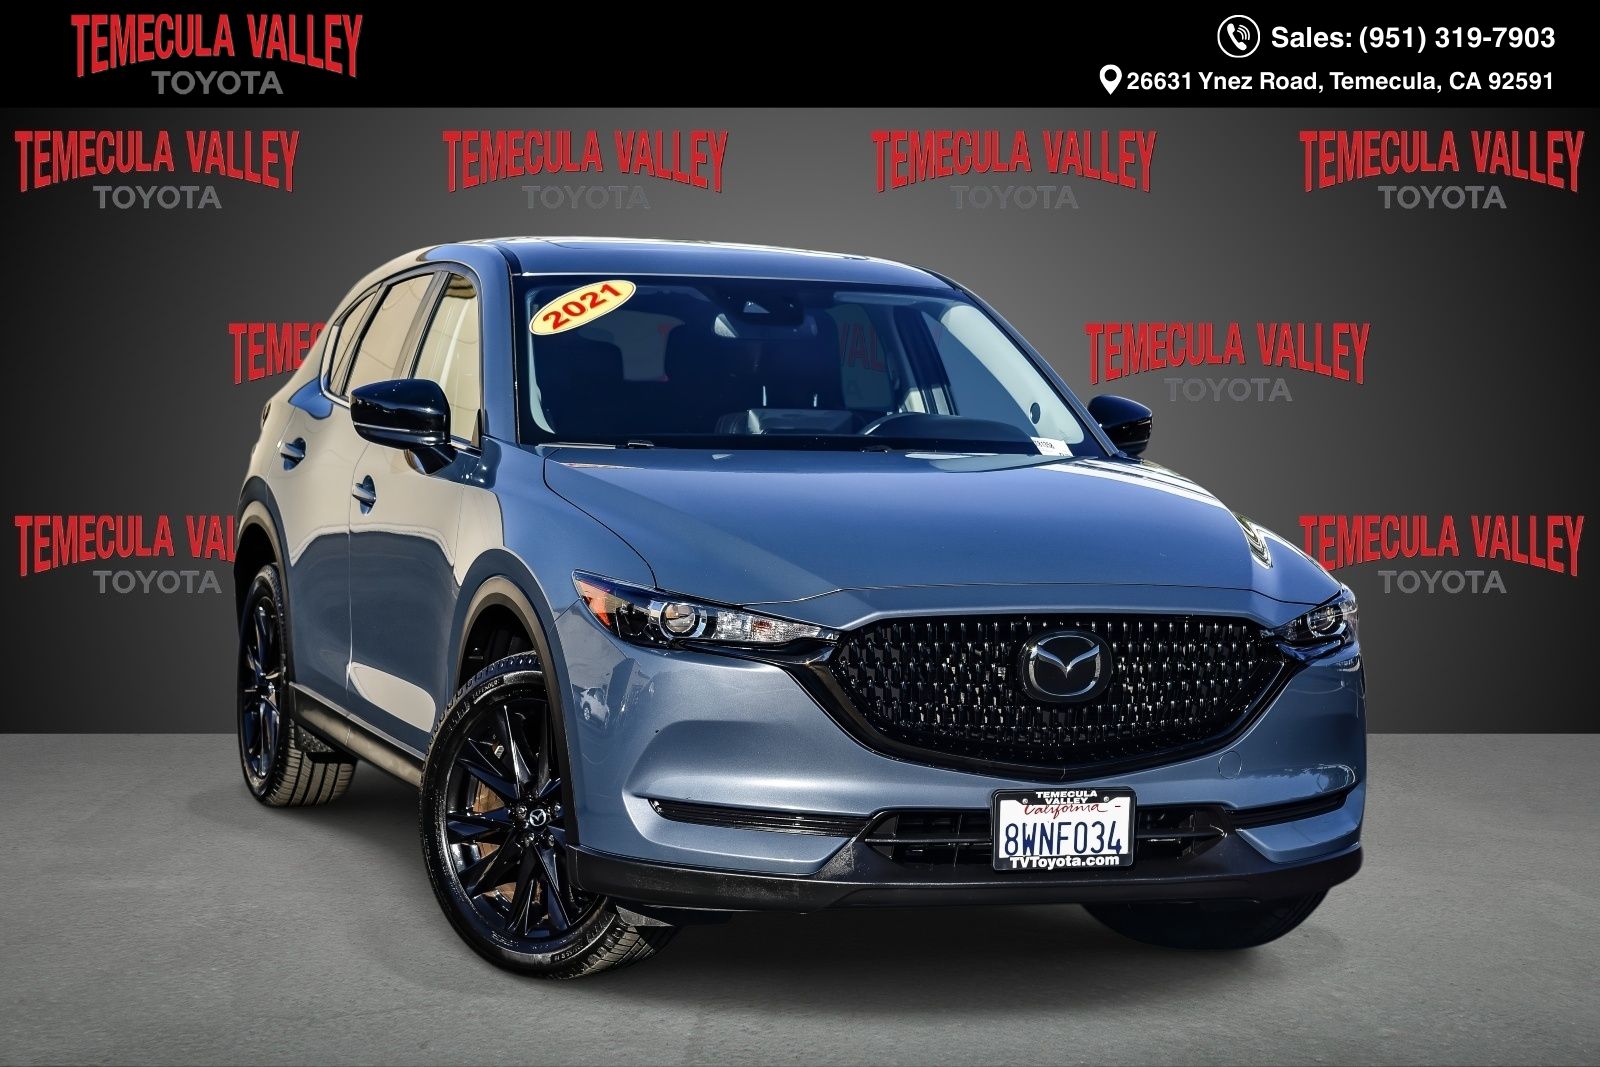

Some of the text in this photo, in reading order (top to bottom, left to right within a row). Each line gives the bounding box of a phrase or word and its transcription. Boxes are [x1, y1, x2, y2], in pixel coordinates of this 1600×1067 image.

[13, 129, 300, 193] TEMECULA VALLEY
[442, 129, 729, 193] TEMECULA VALLEY
[870, 129, 1158, 193] TEMECULA VALLEY
[1298, 129, 1585, 193] TEMECULA VALLEY
[93, 185, 222, 209] TOYOTA
[522, 185, 651, 209] TOYOTA
[950, 185, 1079, 209] TOYOTA
[1378, 185, 1507, 209] TOYOTA
[542, 283, 622, 330] 2021
[1084, 322, 1371, 385] TEMECULA VALLEY
[1164, 377, 1293, 402] TOYOTA
[13, 514, 175, 577] TEMECULA
[1299, 514, 1585, 577] TEMECULA VALLEY
[93, 570, 222, 594] TOYOTA
[1378, 570, 1507, 594] TOYOTA
[1035, 790, 1098, 799] TEMECULA
[1045, 797, 1089, 805] VALLEY
[1023, 803, 1108, 820] California
[1004, 821, 1123, 856] 8WNF034
[1009, 855, 1120, 871] TVToyota.com
